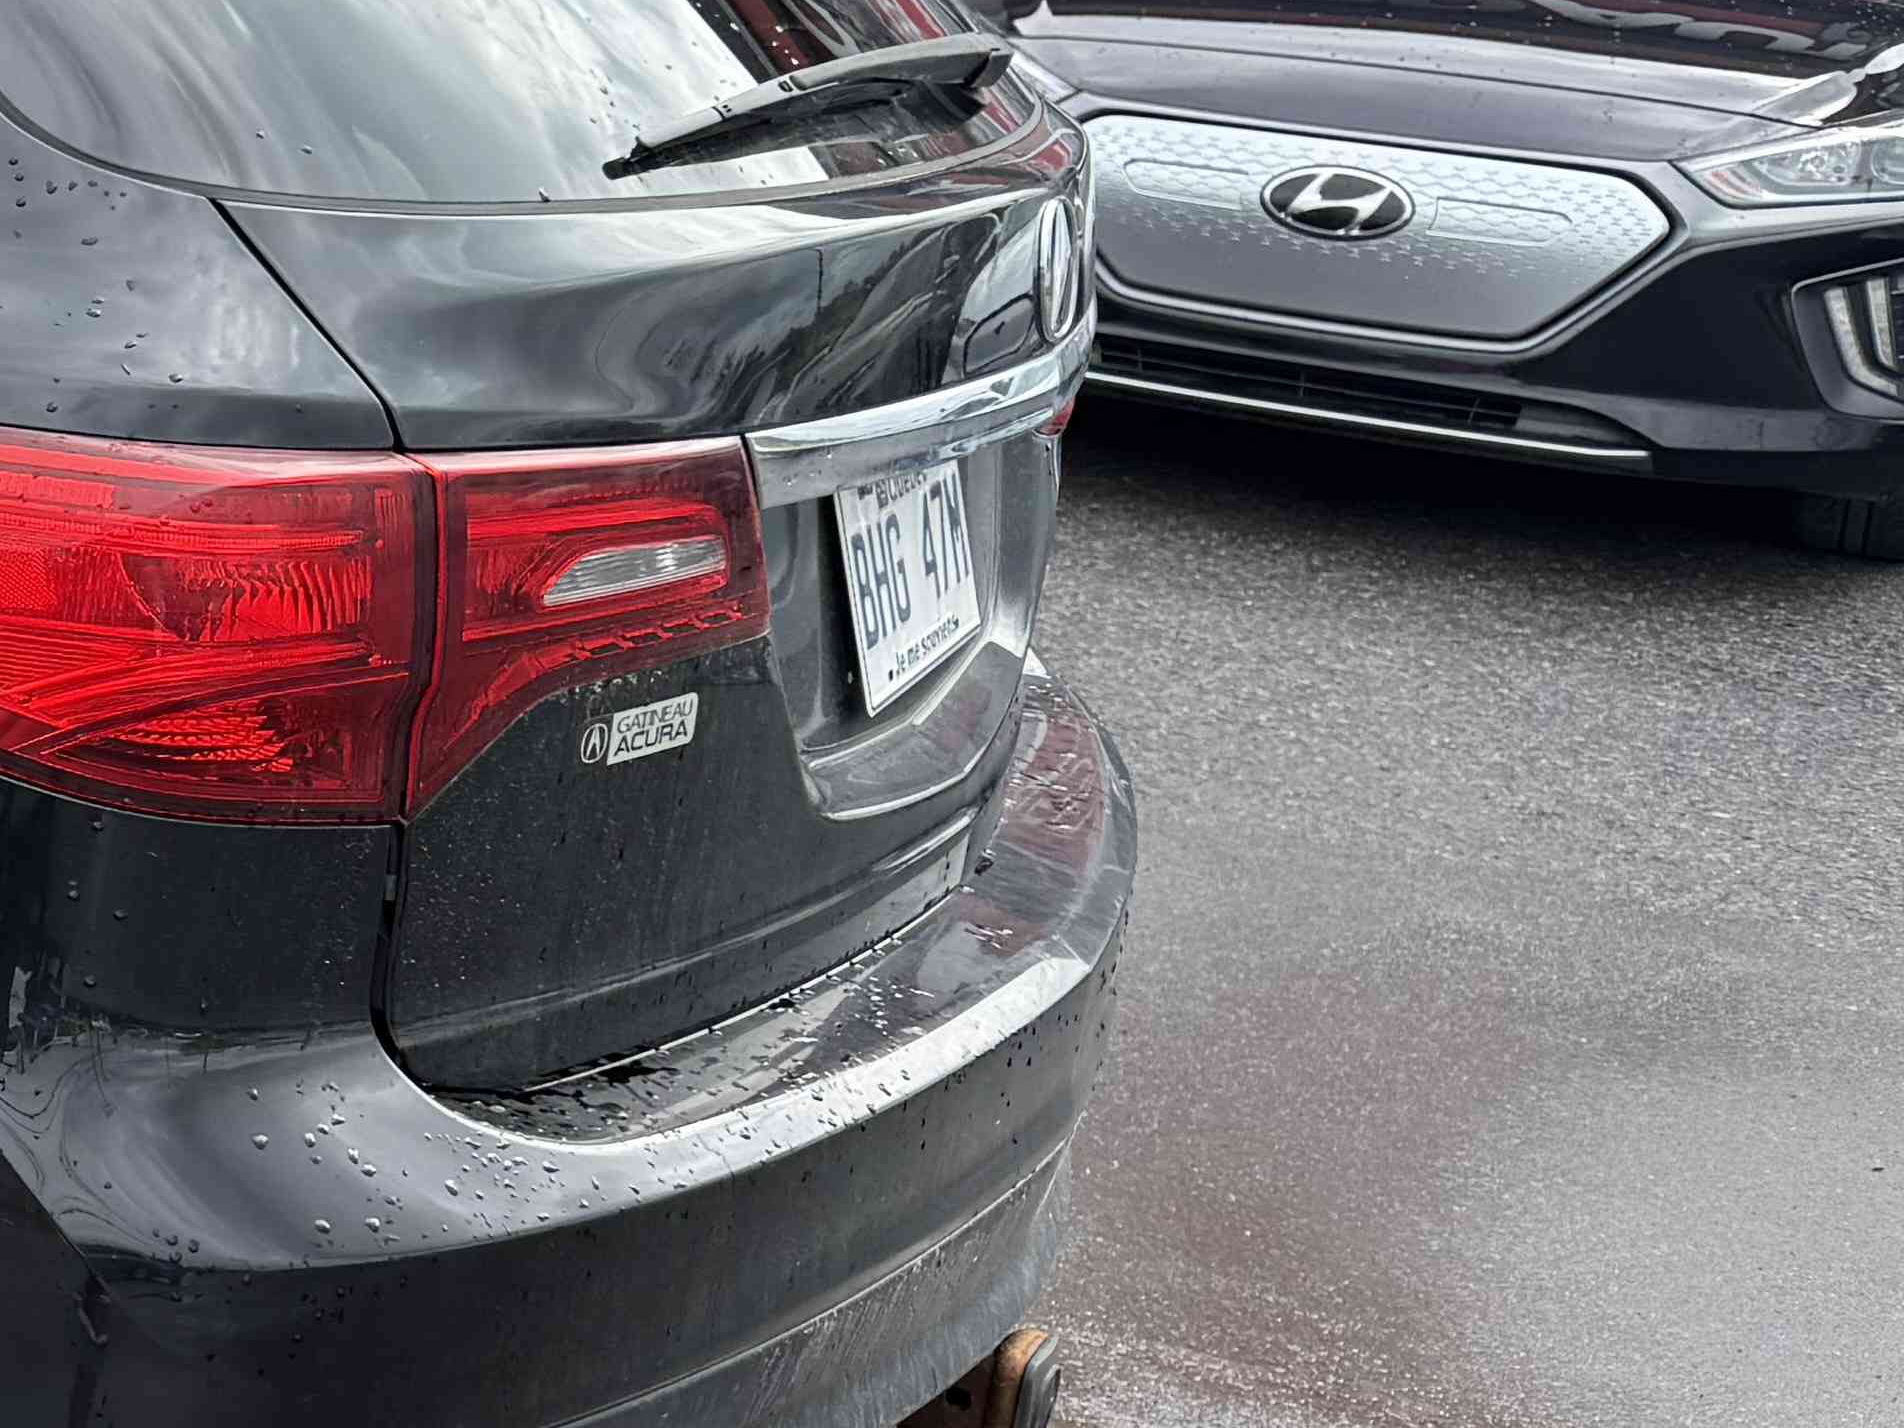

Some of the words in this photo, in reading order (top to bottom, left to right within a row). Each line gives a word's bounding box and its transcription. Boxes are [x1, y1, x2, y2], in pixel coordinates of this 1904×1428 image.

[851, 513, 911, 650] BHG
[923, 473, 969, 599] 47M
[617, 698, 692, 734] GATINEAU
[613, 719, 688, 757] ACURA
